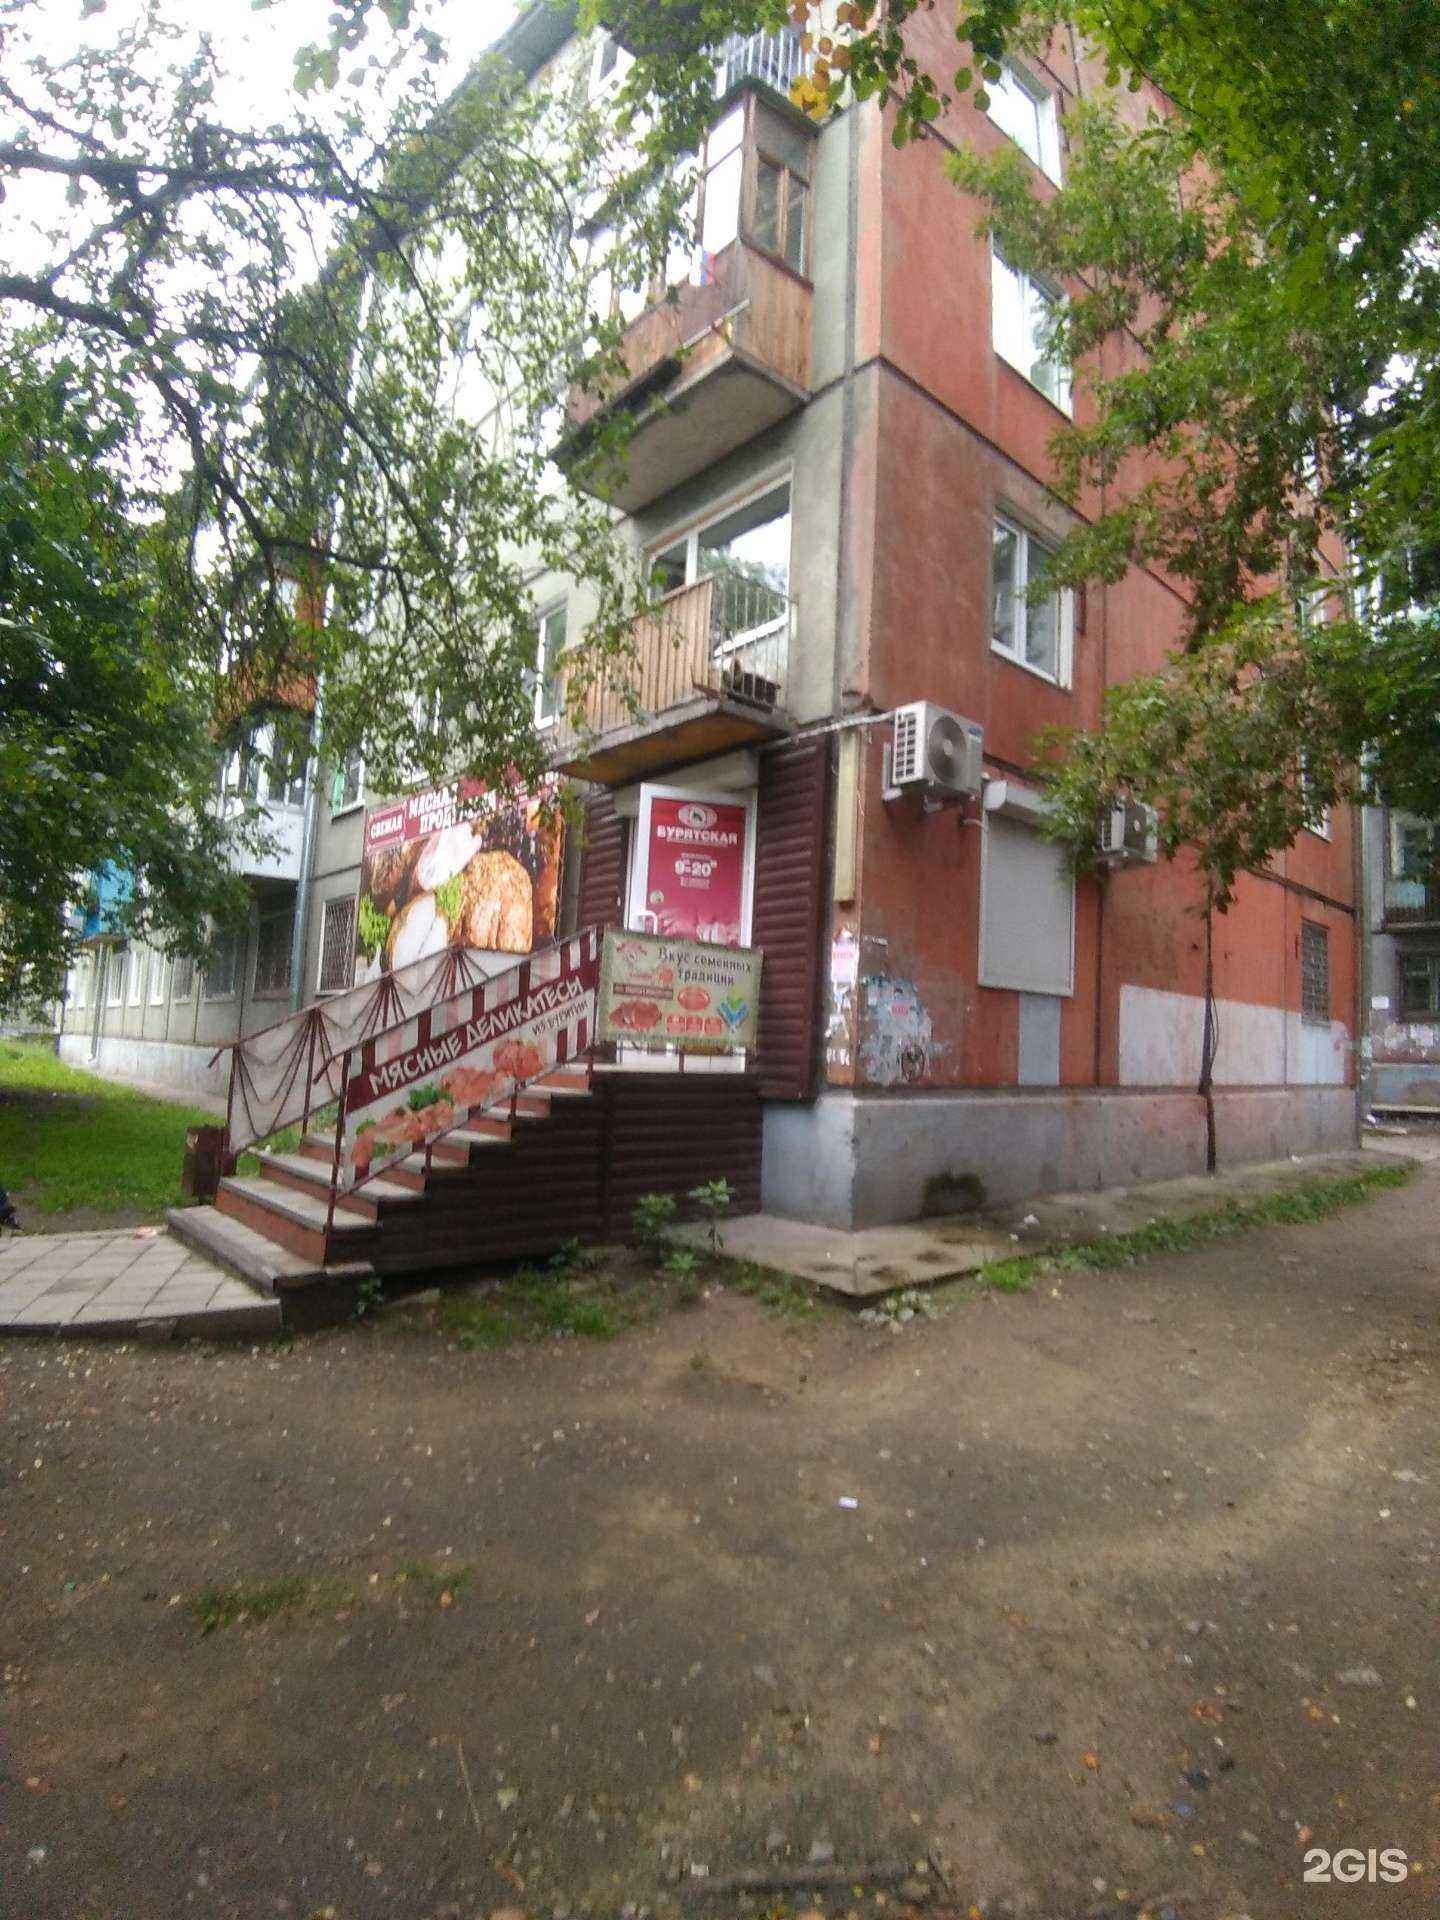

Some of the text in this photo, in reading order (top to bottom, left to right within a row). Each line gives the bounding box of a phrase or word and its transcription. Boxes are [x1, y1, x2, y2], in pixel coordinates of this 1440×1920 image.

[656, 825, 738, 846] БУРЯТСКАЯ
[368, 975, 584, 1095] МЯСНЫЕ ДЕЛИКАТЕСЫ
